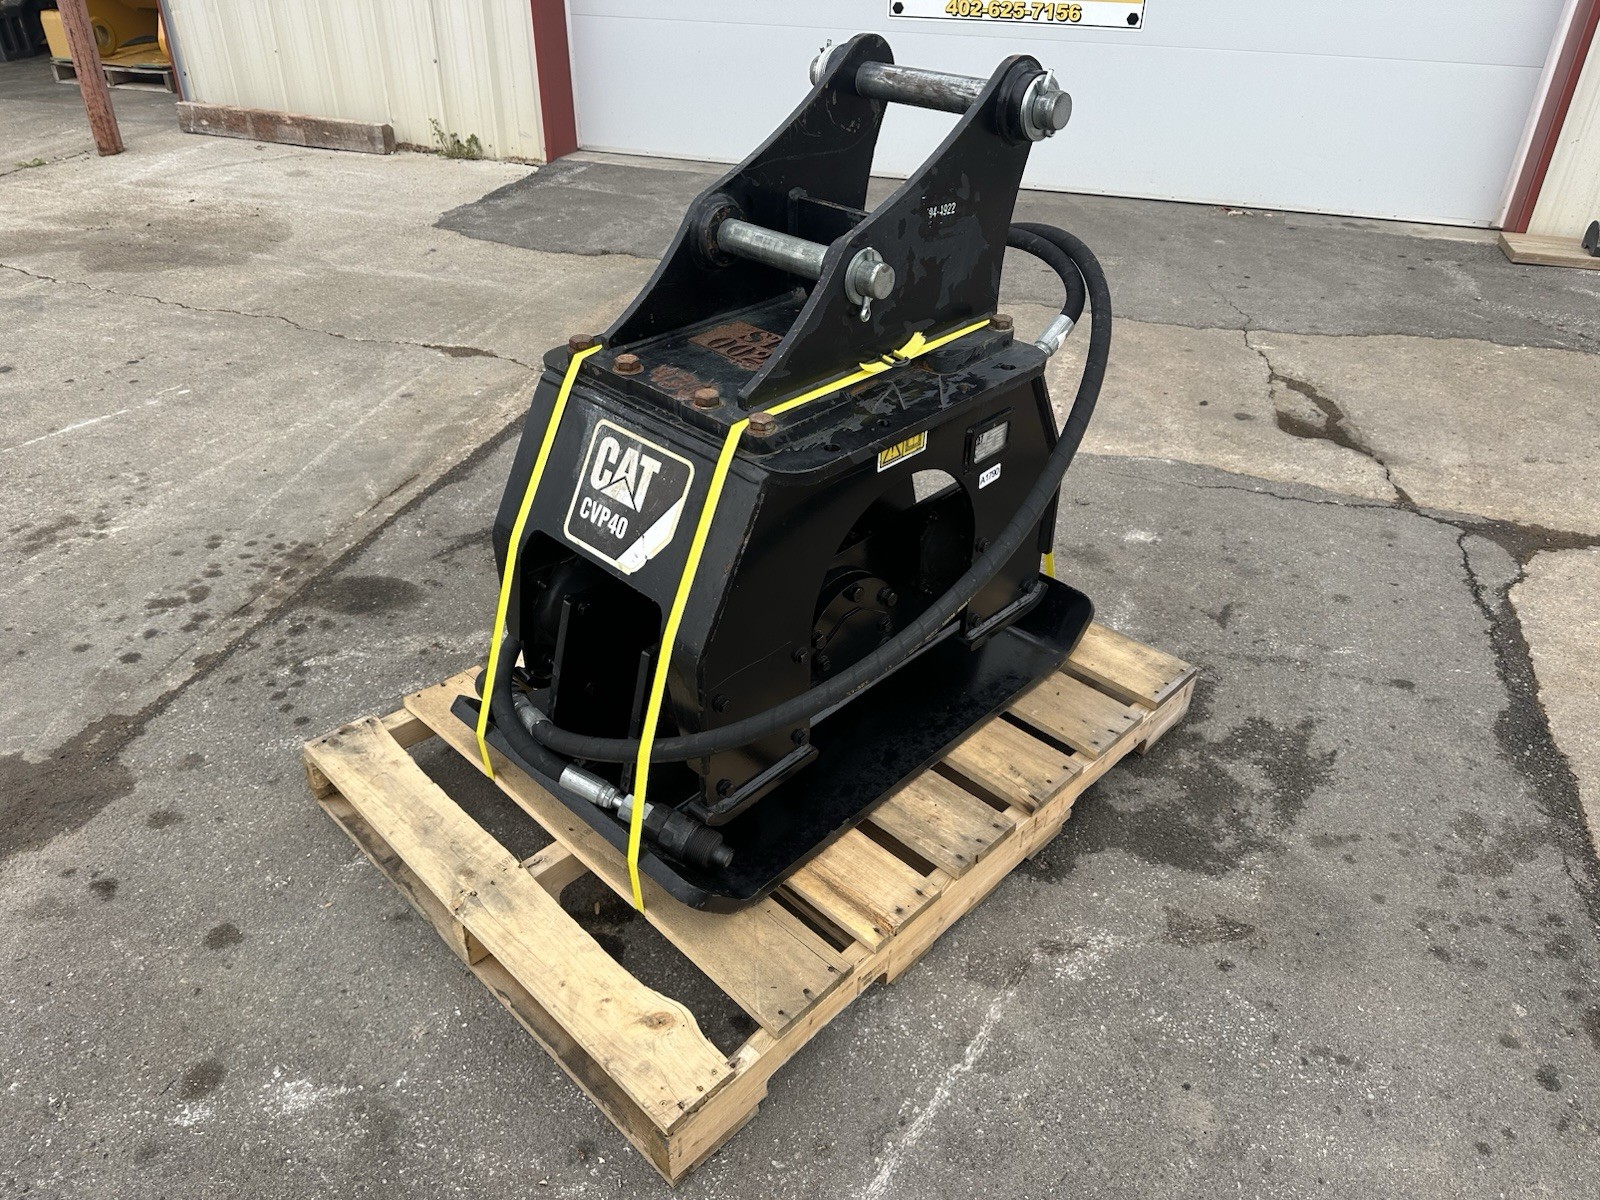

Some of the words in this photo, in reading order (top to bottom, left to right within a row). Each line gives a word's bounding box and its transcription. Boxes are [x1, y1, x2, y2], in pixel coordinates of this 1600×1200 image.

[945, 0, 1082, 22] 402-625-7156
[590, 436, 663, 513] CAT
[579, 496, 629, 540] CVP40
